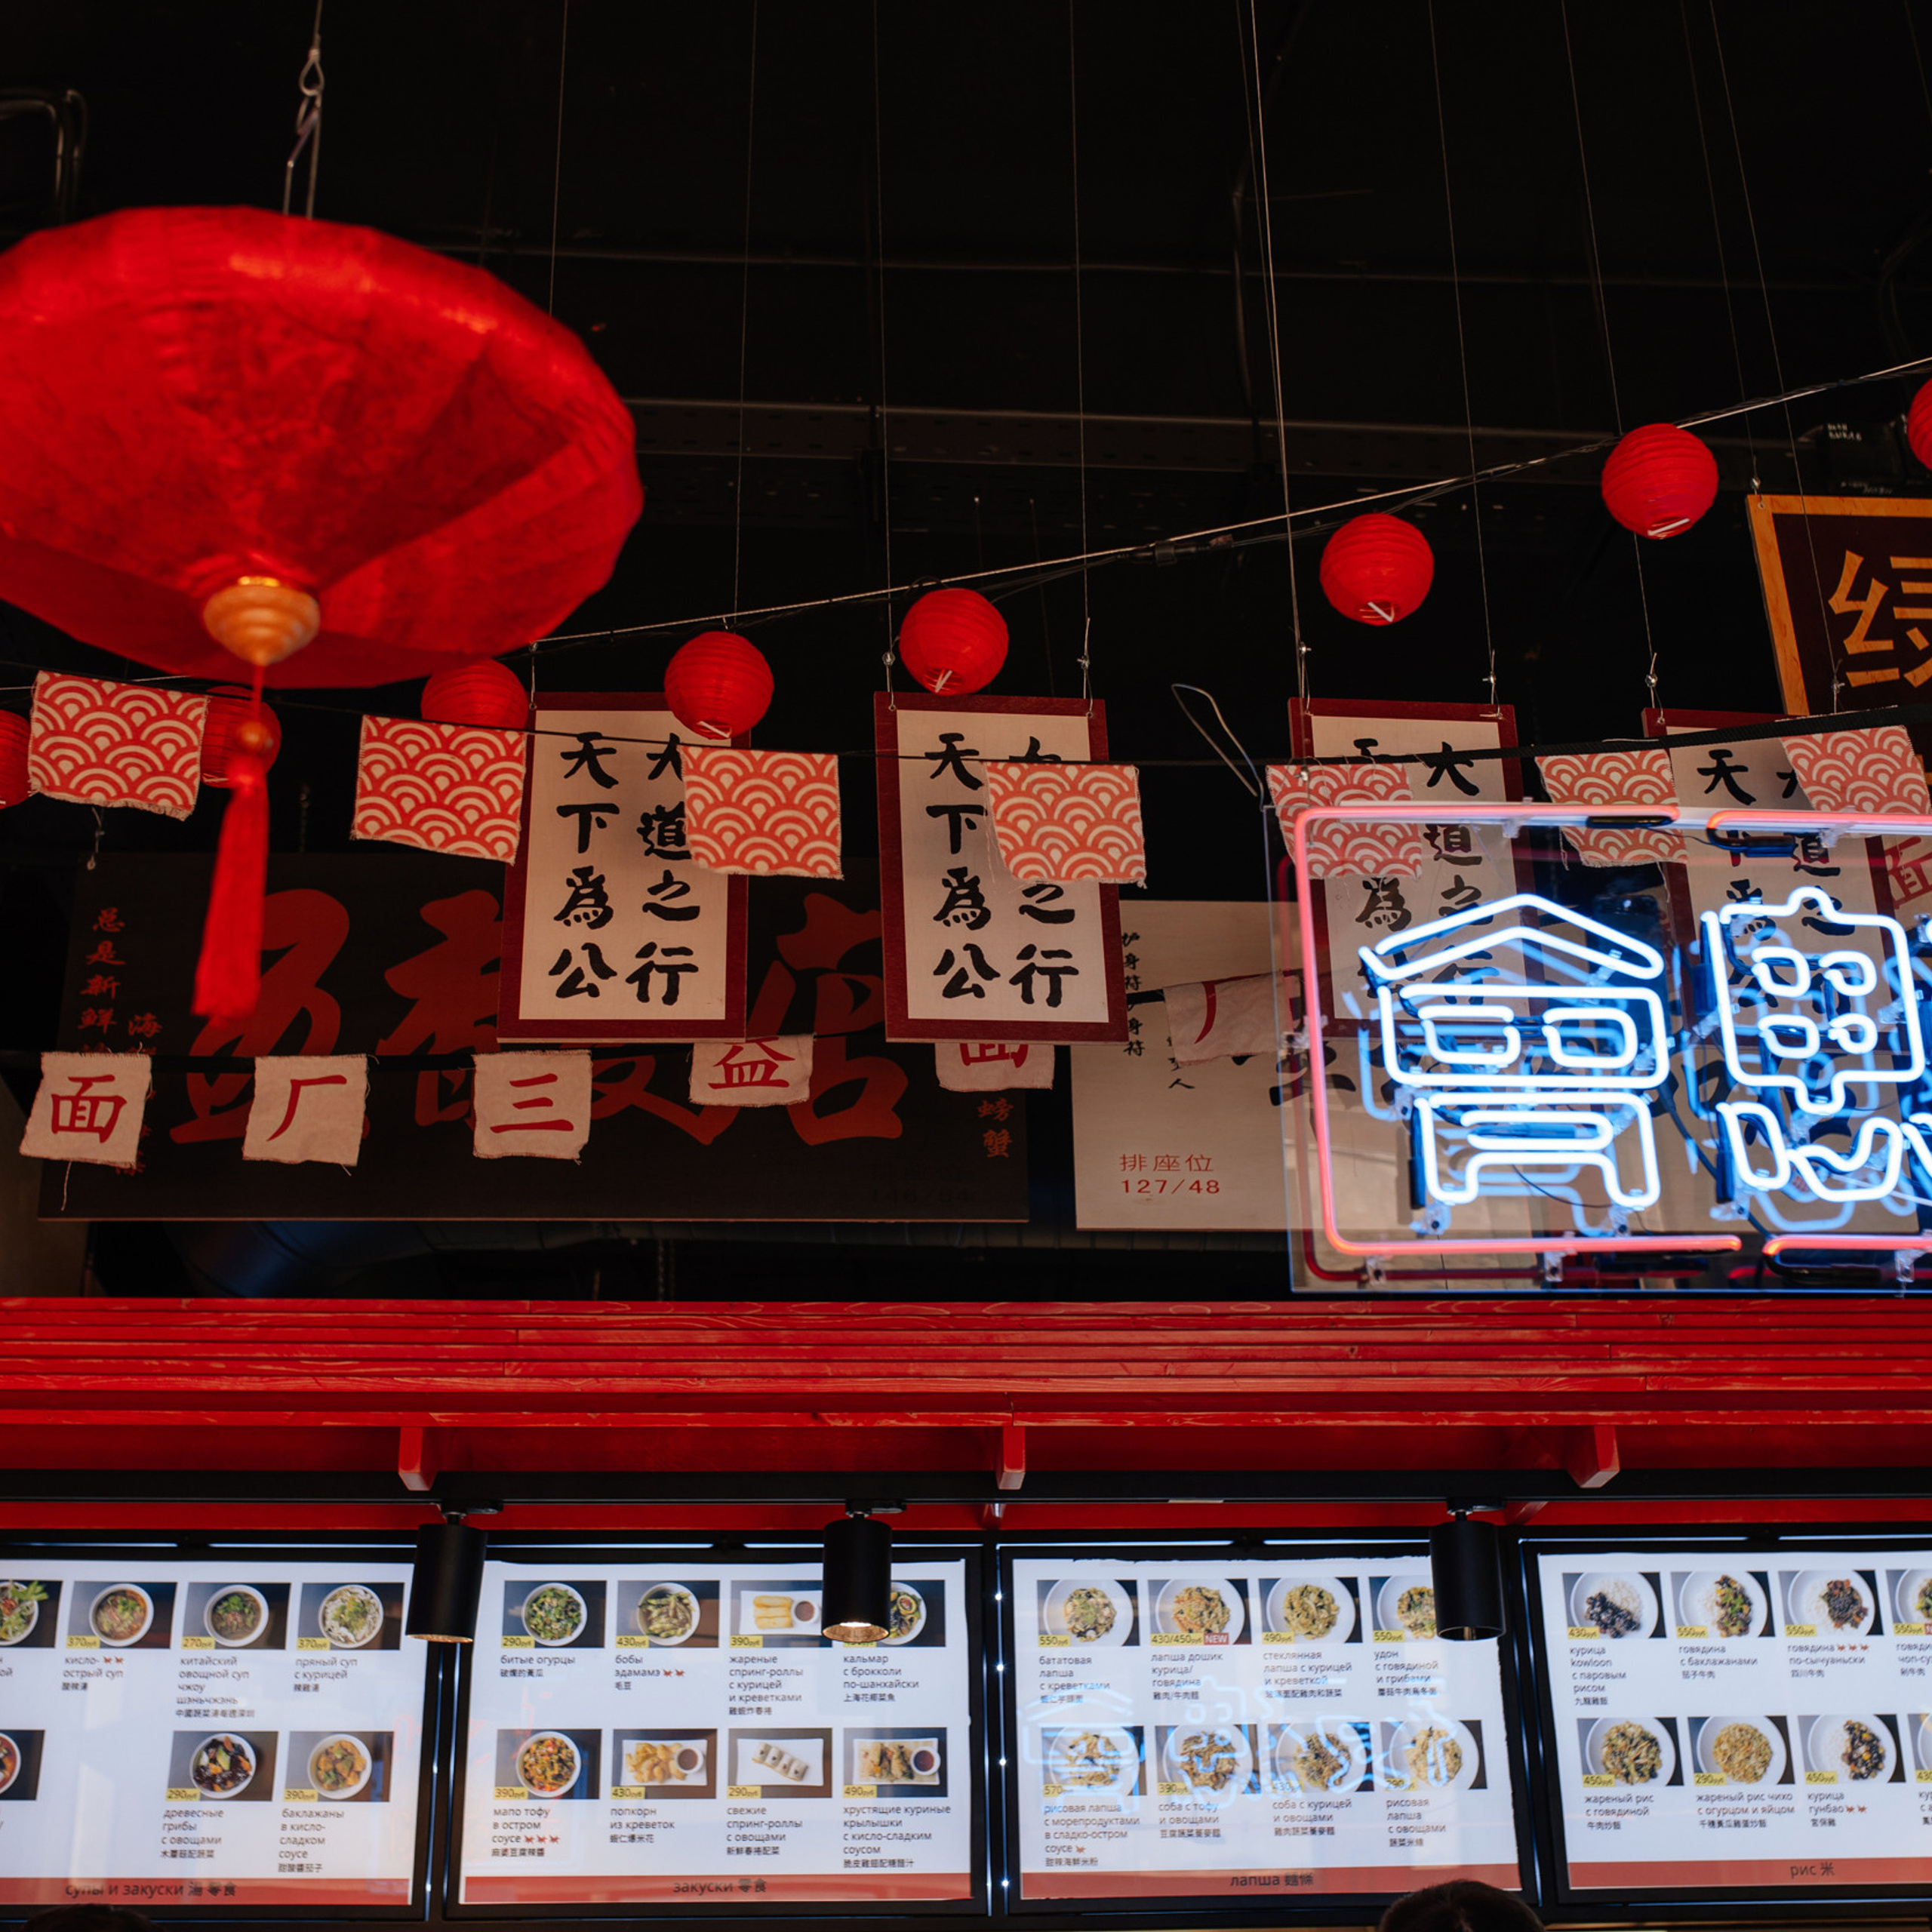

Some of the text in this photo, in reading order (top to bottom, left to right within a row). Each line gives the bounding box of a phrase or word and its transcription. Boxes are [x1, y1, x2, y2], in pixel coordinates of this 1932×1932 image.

[491, 1072, 574, 1134] 三
[51, 1074, 127, 1143] 面
[1119, 1153, 1214, 1172] 排座位
[1121, 1179, 1220, 1195] 127/48
[1204, 1635, 1228, 1644] NEW
[1263, 1651, 1322, 1660] стеклянная
[1374, 1651, 1398, 1660] удон
[1570, 1646, 1606, 1657] курица
[180, 1657, 238, 1666] китайский
[296, 1658, 358, 1668] пряный суп
[500, 1655, 576, 1666] битые огурцы
[615, 1655, 643, 1664] бобы
[729, 1656, 778, 1665] жареные
[843, 1656, 889, 1665] кальмар
[1039, 1656, 1092, 1665] бататовая
[1151, 1653, 1223, 1663] лапша дошик
[1687, 1656, 1758, 1666] баклажанами
[851, 1666, 902, 1676] брокколи
[1152, 1665, 1193, 1676] курица/
[1263, 1664, 1297, 1672] лапша
[1308, 1662, 1352, 1672] курицей
[1383, 1661, 1438, 1672] говядиной
[63, 1669, 124, 1680] острый суп
[179, 1670, 249, 1680] овощной суп
[302, 1670, 348, 1680] курицей
[615, 1669, 661, 1678] эдамамэ
[729, 1668, 803, 1678] спринг-роллы
[1039, 1669, 1074, 1678] лапша
[1580, 1672, 1626, 1681] паровым
[1152, 1678, 1201, 1687] говядина
[1274, 1675, 1328, 1686] креветкой
[1386, 1674, 1431, 1684] грибами
[737, 1679, 782, 1690] курицей
[843, 1680, 919, 1690] по-шанхайски
[1048, 1682, 1110, 1691] креветками
[1574, 1684, 1605, 1694] рисом
[739, 1694, 801, 1704] креветками
[1585, 1794, 1654, 1804] жареный рис
[1697, 1792, 1744, 1803] жареный
[1747, 1792, 1765, 1802] рис
[1807, 1791, 1844, 1801] курица
[1158, 1801, 1183, 1811] соба
[1193, 1802, 1218, 1814] тофу
[1272, 1799, 1297, 1810] соба
[1307, 1798, 1352, 1810] курицей
[1386, 1798, 1429, 1809] рисовая
[163, 1809, 224, 1818] древесные
[281, 1808, 344, 1818] баклажаны
[494, 1807, 551, 1819] мапо тофу
[610, 1808, 657, 1817] попкорн
[727, 1807, 767, 1816] свежие
[843, 1806, 951, 1817] хрустящие куриные
[1044, 1804, 1122, 1815] рисовая лапша
[1593, 1807, 1650, 1817] говядиной
[1705, 1806, 1749, 1817] огурцом
[1761, 1804, 1795, 1815] яйцом
[1169, 1816, 1220, 1825] овощами
[1283, 1814, 1334, 1823] овощами
[1387, 1812, 1422, 1820] лапша
[162, 1821, 197, 1832] грибы
[502, 1823, 541, 1831] остром
[626, 1821, 675, 1831] креветок
[727, 1819, 802, 1829] спринг-роллы
[843, 1819, 903, 1829] крылышки
[1052, 1817, 1140, 1827] морепродуктами
[1395, 1824, 1446, 1834] овощами
[492, 1835, 521, 1845] соусе
[734, 1834, 786, 1843] овощами
[851, 1832, 932, 1841] кисло-сладким
[1053, 1829, 1128, 1841] сладко-остром
[169, 1836, 222, 1846] овощами
[280, 1836, 325, 1846] сладком
[843, 1846, 881, 1856] соусом
[1044, 1844, 1073, 1854] соусе
[278, 1850, 308, 1860] соусе
[1790, 1862, 1835, 1878] рис 米
[1230, 1876, 1280, 1887] лапша
[66, 1884, 183, 1899] супы и закуски
[673, 1881, 734, 1896] закуски
